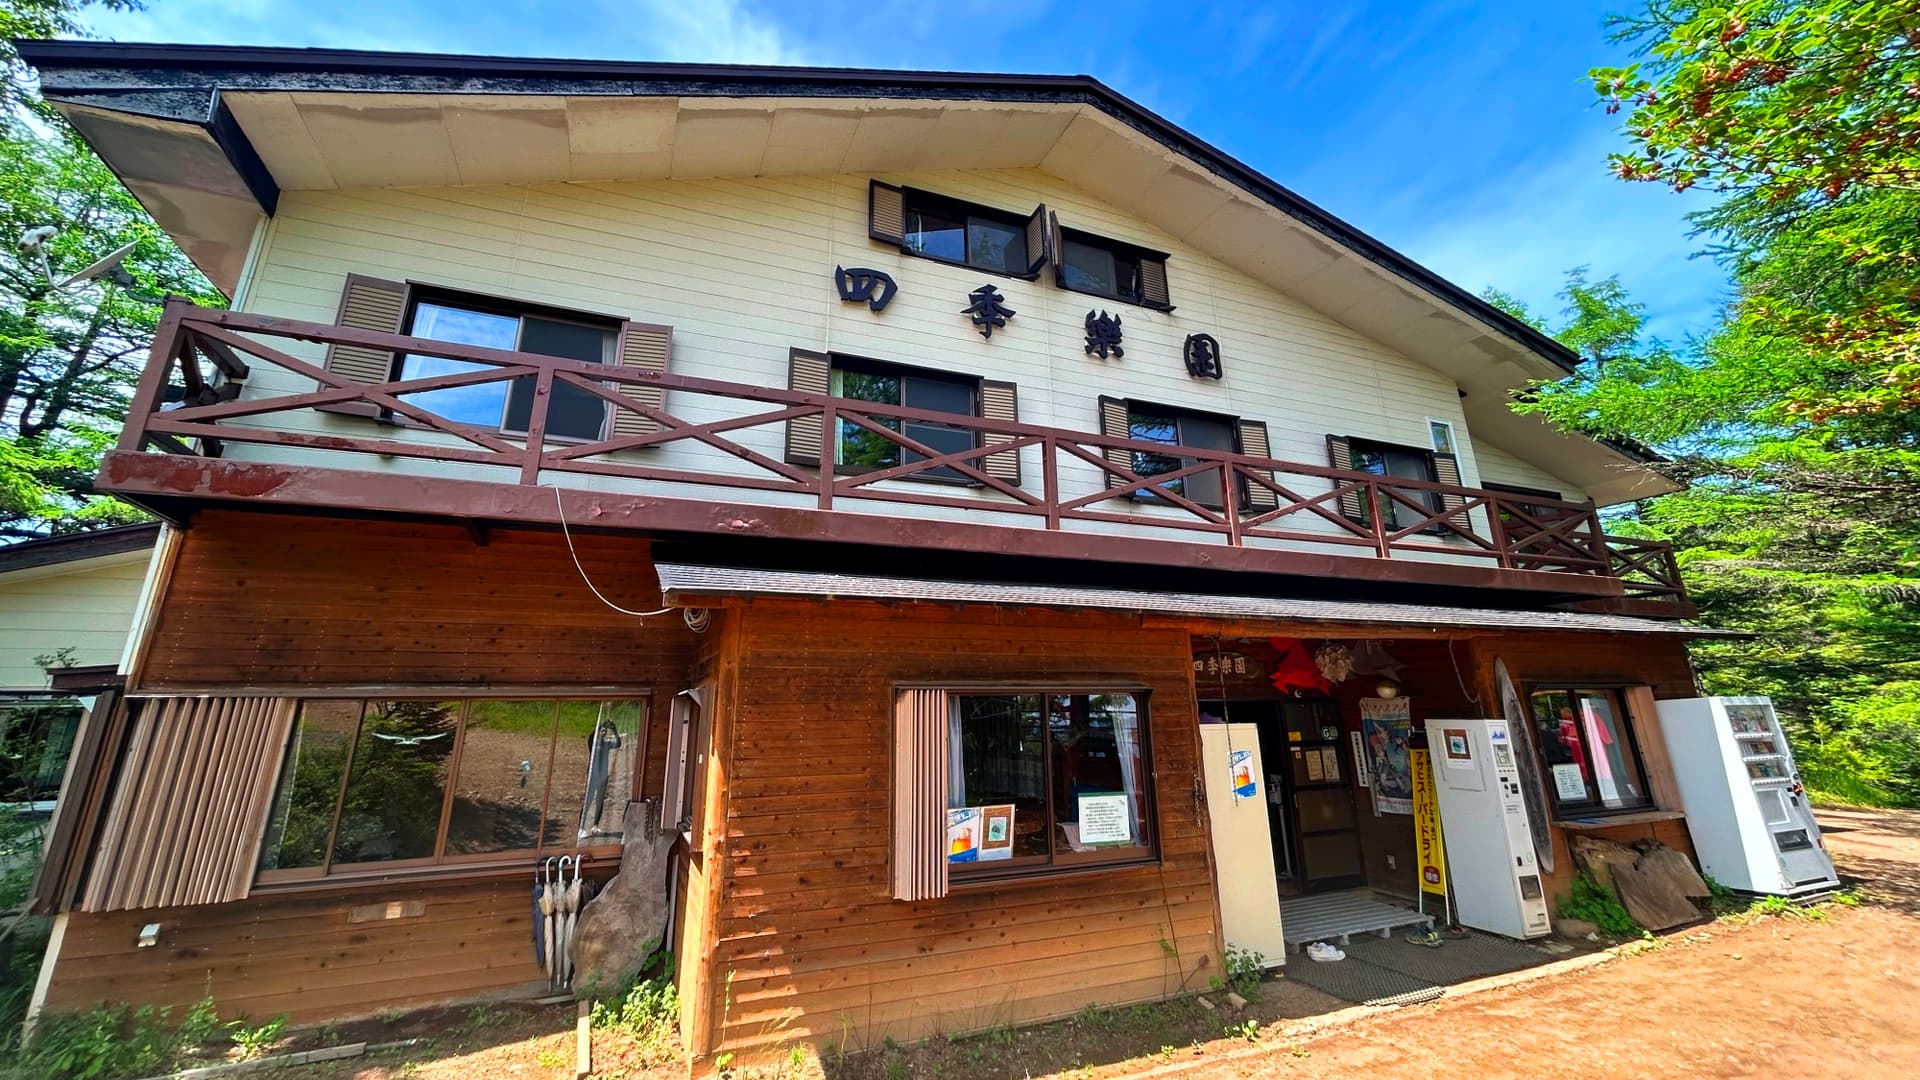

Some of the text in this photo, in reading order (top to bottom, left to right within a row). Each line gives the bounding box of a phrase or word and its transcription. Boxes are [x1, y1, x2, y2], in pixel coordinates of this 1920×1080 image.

[1416, 752, 1431, 865] アサヒスーパードライ
